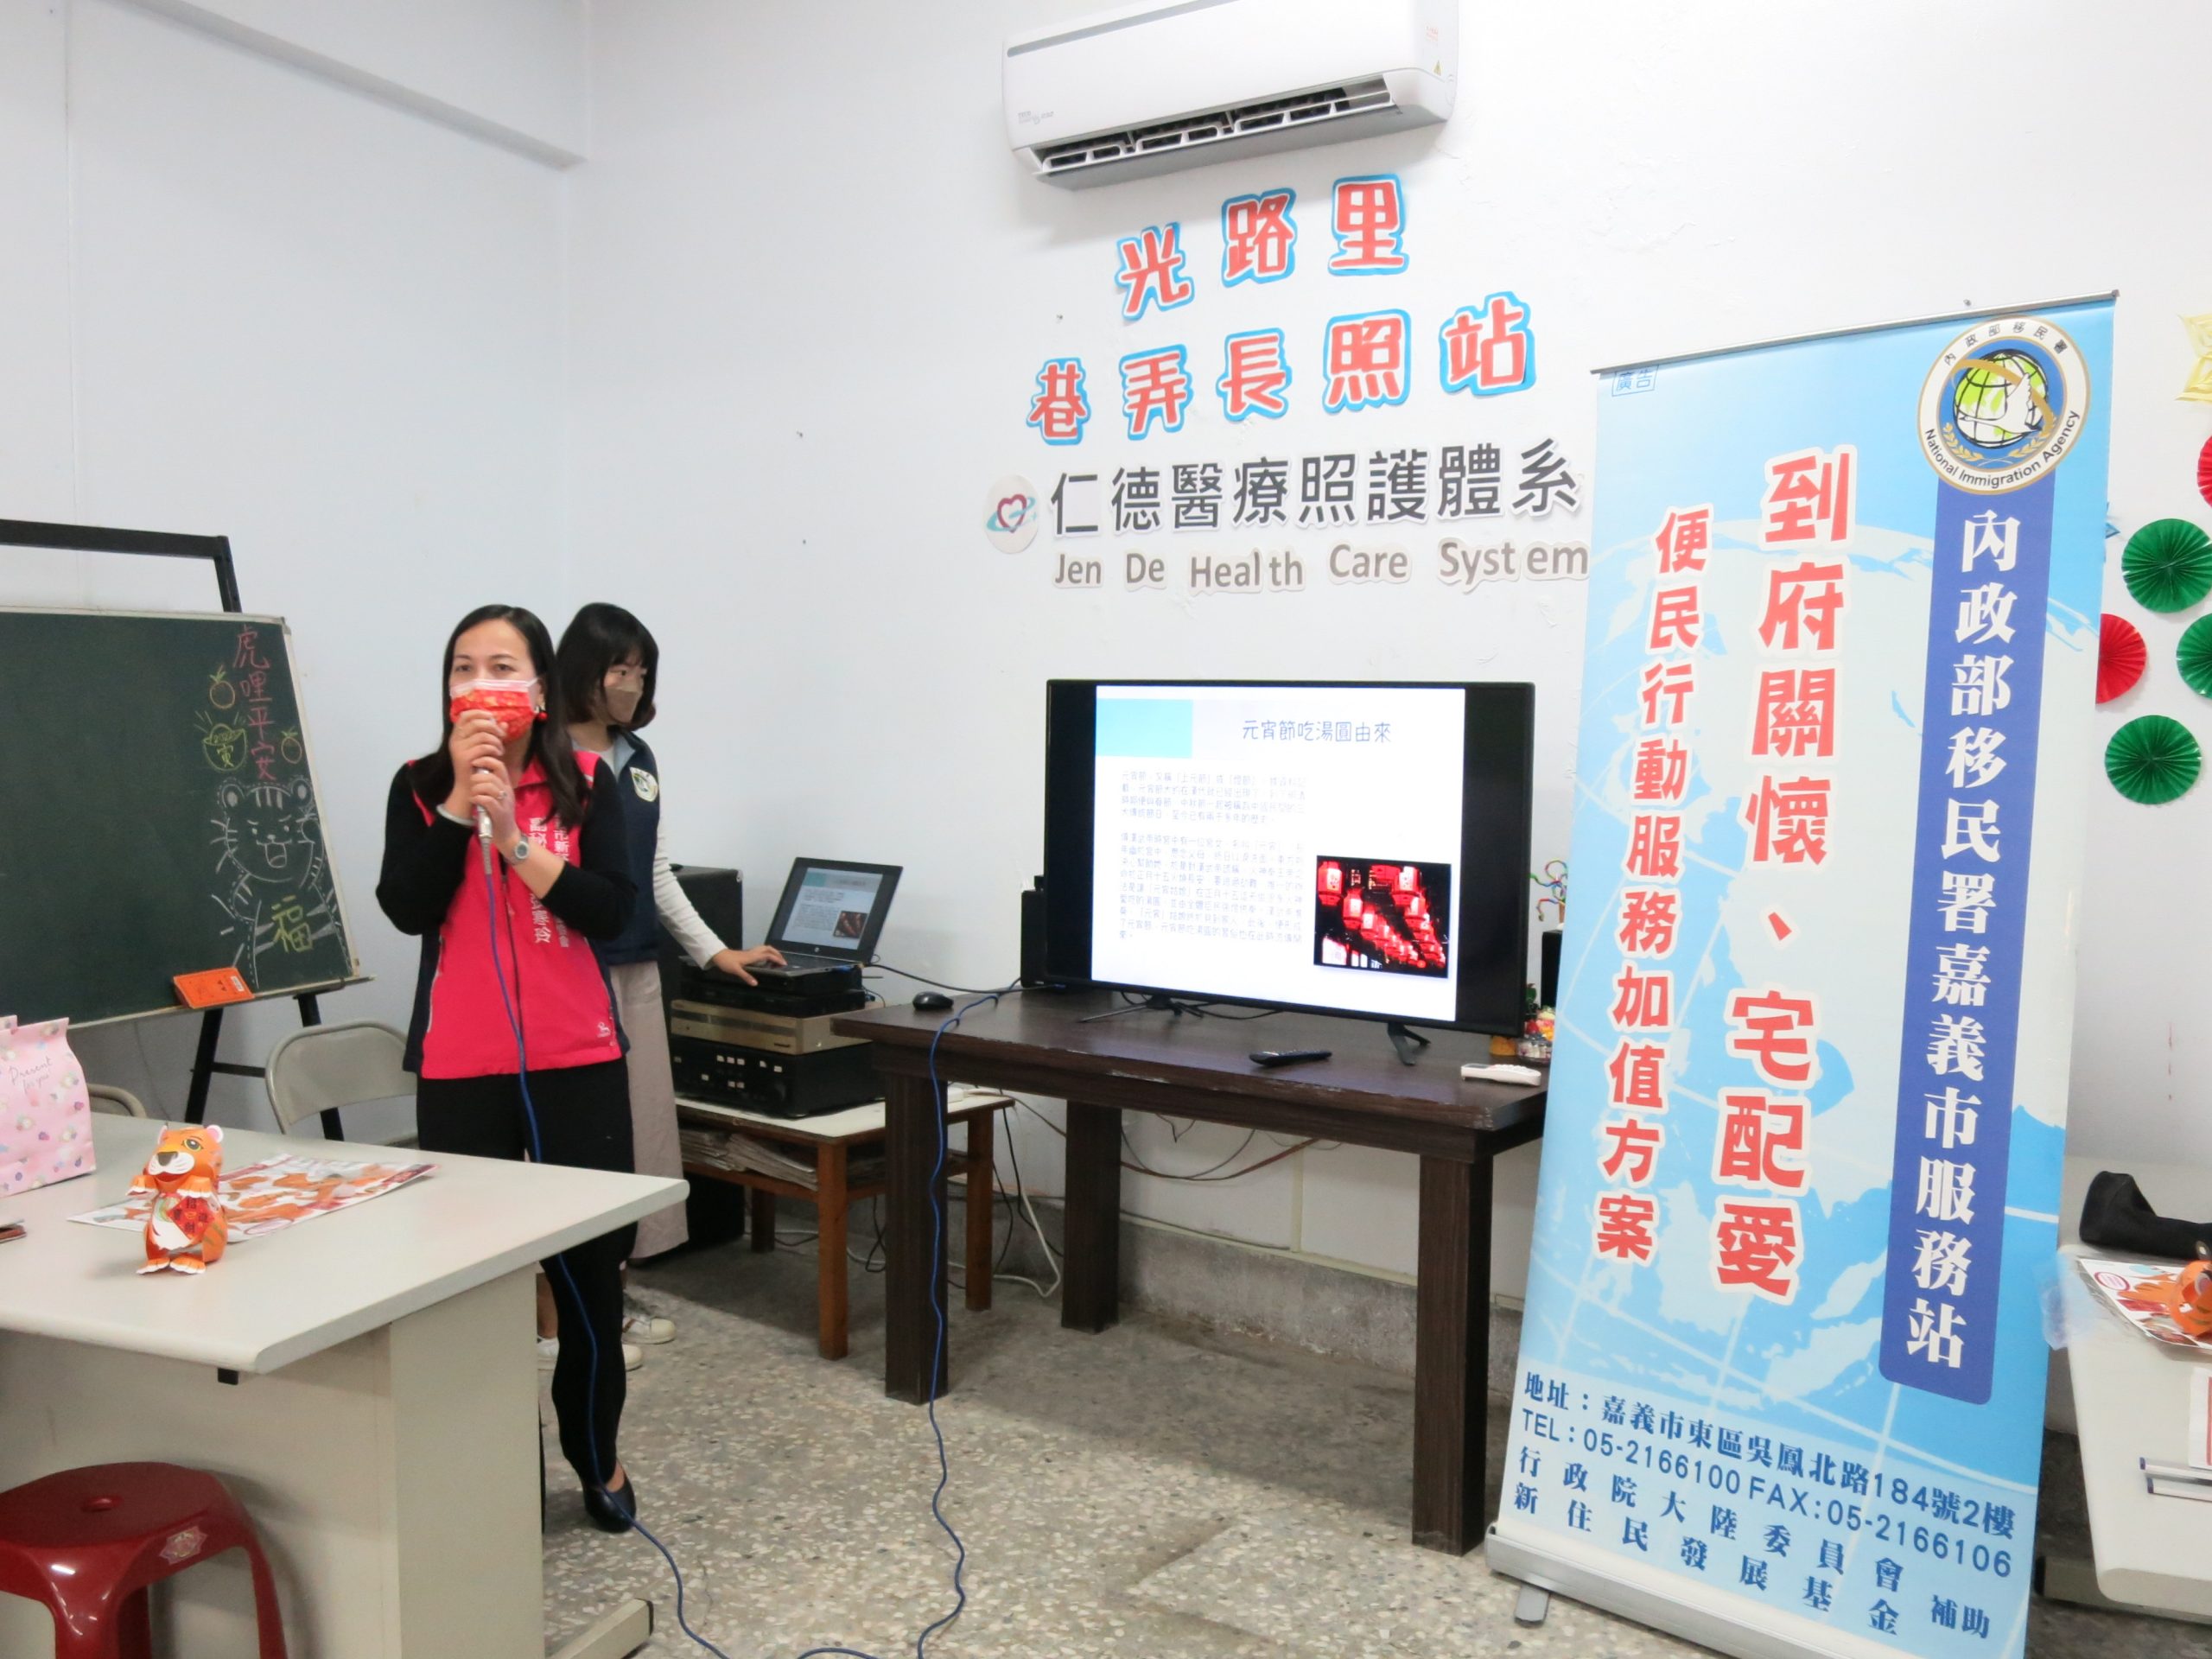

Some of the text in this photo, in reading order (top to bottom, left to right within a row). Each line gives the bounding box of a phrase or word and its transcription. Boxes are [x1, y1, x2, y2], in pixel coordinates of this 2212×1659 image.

[1117, 177, 1408, 319] 光路里
[1030, 295, 1532, 443] 巷弄長照站
[1049, 438, 1579, 537] 仁德醫療照護體系
[1924, 410, 2081, 489] National Immigration Agency
[1054, 541, 1589, 588] Jen De Health Care System
[1243, 719, 1392, 744] 元宵節吃湯圓由來
[270, 893, 314, 952] 福
[1596, 506, 1711, 1263] 便民行動服務加值方案
[1715, 450, 1853, 1299] 到府關懷、宅配愛
[1906, 509, 2021, 1369] 內政部移民署嘉義市服務站
[1929, 1593, 1991, 1640] 補助
